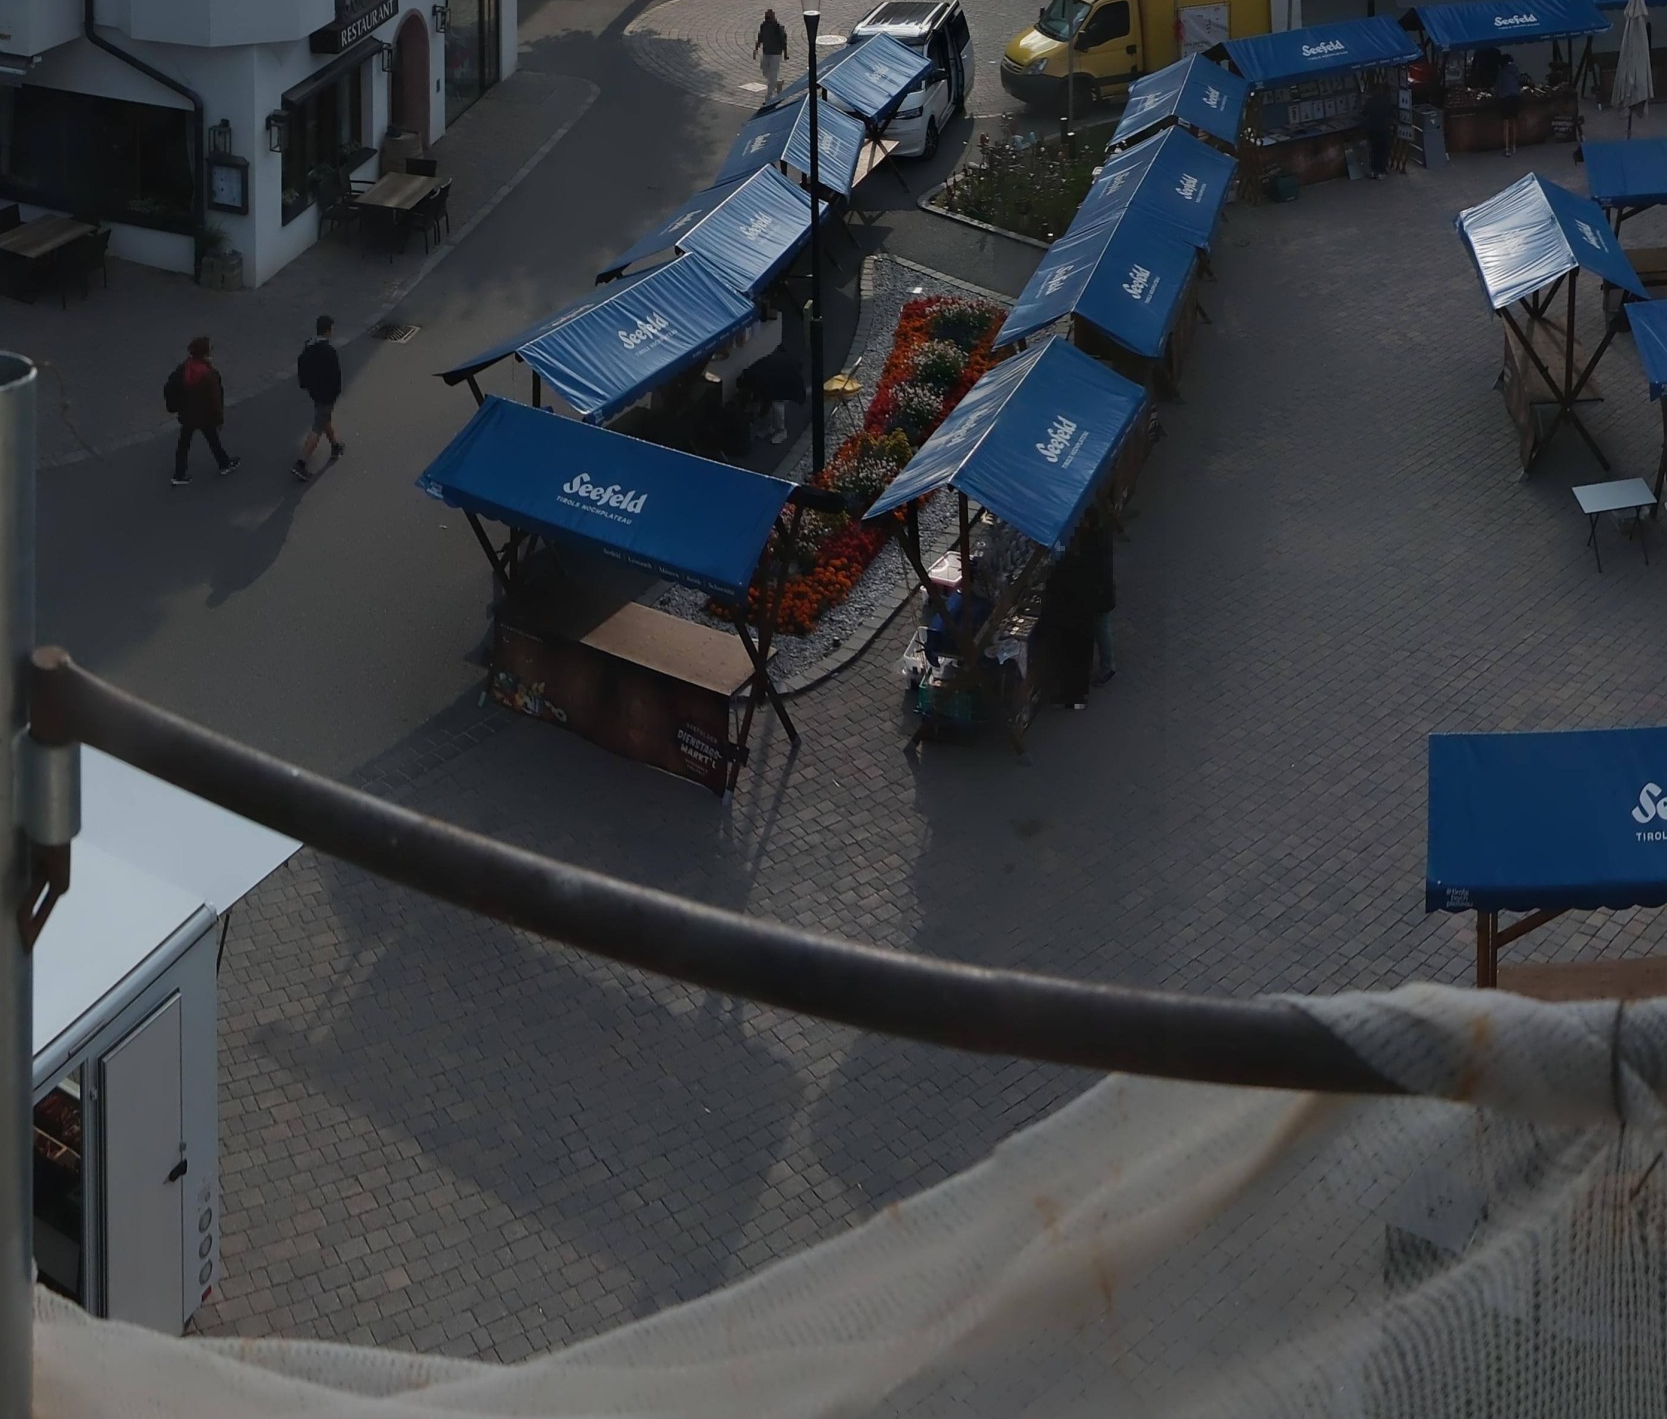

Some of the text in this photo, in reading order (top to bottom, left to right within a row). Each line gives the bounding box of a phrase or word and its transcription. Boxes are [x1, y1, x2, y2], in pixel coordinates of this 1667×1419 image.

[1494, 14, 1538, 27] Seefeld
[1302, 40, 1345, 58] Seefeld
[618, 312, 669, 350] Seefeld
[1036, 415, 1078, 463] Seefeld
[563, 472, 648, 514] Seefeld
